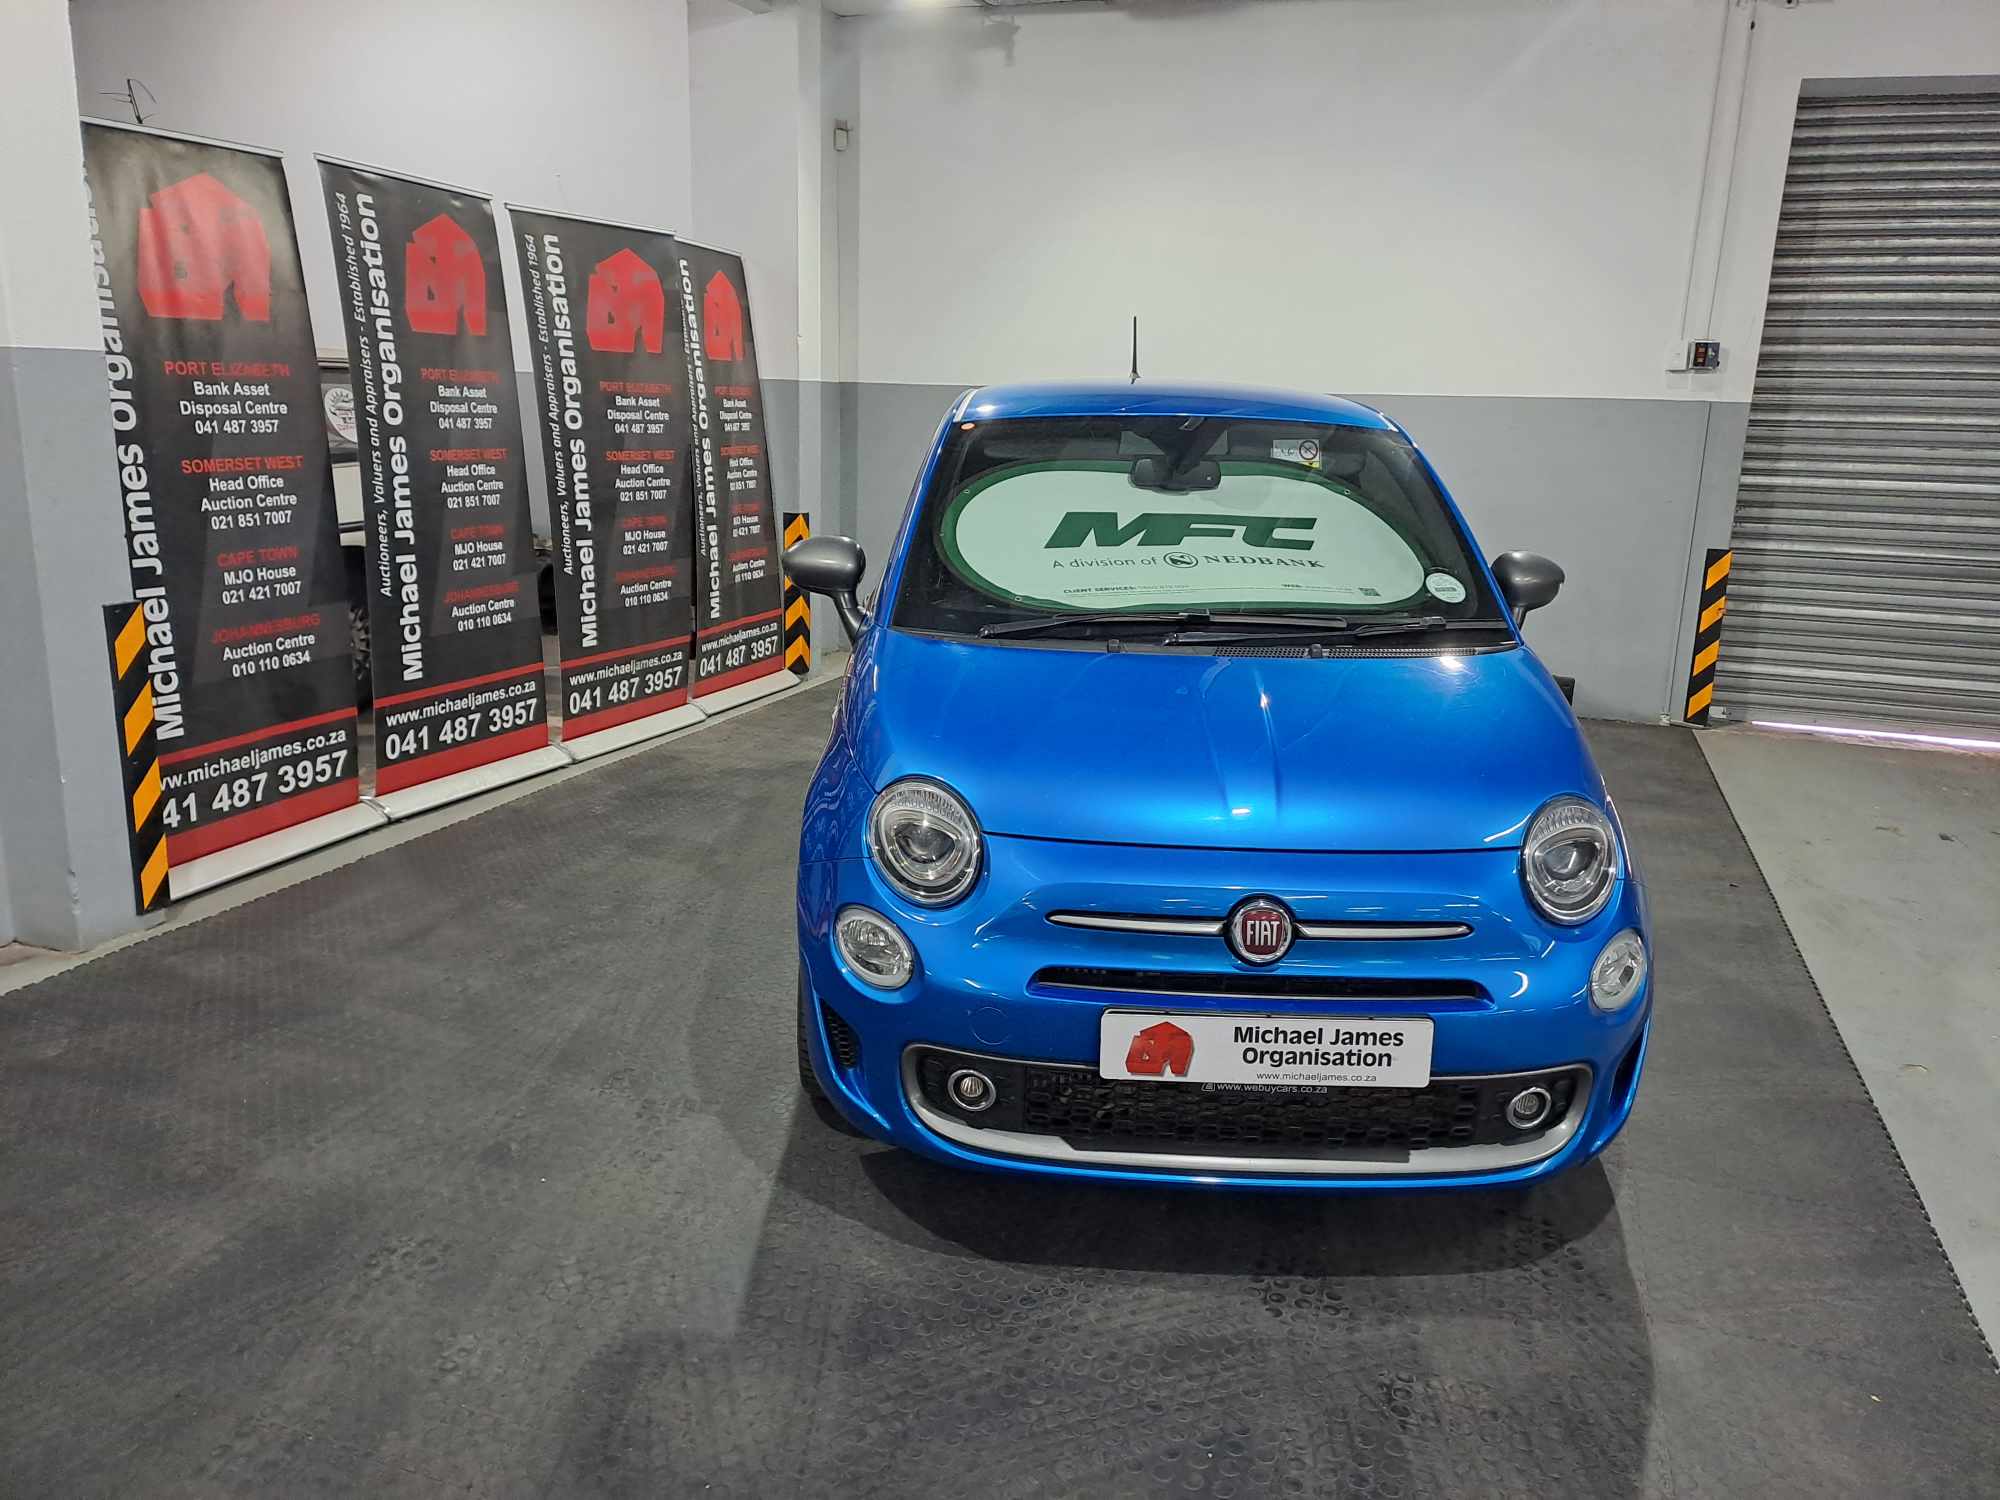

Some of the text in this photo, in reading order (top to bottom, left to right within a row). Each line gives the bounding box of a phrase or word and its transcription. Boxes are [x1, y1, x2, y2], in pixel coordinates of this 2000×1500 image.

[335, 191, 352, 230] 1964
[524, 234, 538, 268] 1964
[341, 233, 367, 323] Established
[528, 268, 549, 345] Established
[679, 259, 709, 430] Organisation
[164, 361, 208, 376] PORT
[358, 334, 379, 415] Appraisers
[193, 381, 271, 396] Bank Asset
[438, 385, 487, 398] Bank Asset
[542, 354, 560, 421] Appraisers
[180, 400, 288, 418] Disposal Centre
[429, 401, 498, 415] Disposal Centre
[615, 395, 660, 408] Bank Asset
[439, 418, 493, 429] 041 487 3957
[607, 409, 669, 421] Disposal Centre
[195, 419, 279, 434] 041 487 3957
[366, 416, 382, 446] and
[549, 422, 562, 448] and
[614, 423, 629, 433] 041
[631, 423, 645, 433] 487
[356, 193, 424, 682] Michael James Organisation
[543, 234, 598, 648] Michael James Organisation
[181, 455, 304, 474] SOMERSET WEST
[446, 464, 496, 477] Head Office
[554, 450, 567, 496] Valuers
[620, 463, 664, 474] Head Office
[209, 474, 285, 492] Head Office
[371, 450, 386, 504] Valuers
[441, 480, 504, 493] Auction Centre
[615, 477, 671, 488] Auction Centre
[701, 437, 717, 518] James
[201, 493, 298, 512] Auction Centre
[447, 494, 500, 508] 021 851 7007
[620, 490, 667, 502] 021 851 7007
[117, 442, 164, 576] James
[211, 510, 292, 530] 021 851 7007
[559, 500, 573, 575] Auctioneers,
[624, 530, 665, 541] MJO House
[1044, 511, 1318, 551] MFC
[376, 509, 393, 598] Auctioneers,
[454, 541, 503, 555] MJO House
[623, 541, 668, 555] 021 421 7007
[453, 554, 506, 571] 021 421 7007
[707, 524, 721, 619] Michael
[1052, 555, 1325, 569] A division of NEDBANK
[223, 566, 297, 586] MJO House
[222, 581, 301, 605] 021 421 7007
[620, 584, 648, 595] Auction
[451, 599, 514, 617] Auction Centre
[625, 597, 638, 607] 010
[640, 594, 651, 605] 110
[458, 618, 474, 631] 010
[476, 615, 491, 628] 110
[223, 634, 316, 661] Auction Centre
[700, 636, 778, 677] 041 487 3957
[135, 586, 185, 741] Michael
[232, 650, 311, 678] 010 110 0634
[569, 651, 682, 686] www.michaeljames.co.za
[569, 665, 682, 715] 041 487 3957
[385, 680, 536, 727] www.michaeljames.co.za
[385, 698, 537, 760] 041 487 3957
[162, 750, 348, 828] 41 487 3957
[1246, 920, 1280, 946] FIAT
[1233, 1026, 1404, 1047] Michael James
[1242, 1047, 1392, 1067] Organisation
[1256, 1072, 1377, 1082] www.michaeljames.co.za
[1216, 1083, 1328, 1094] www.webuycars.co.za
